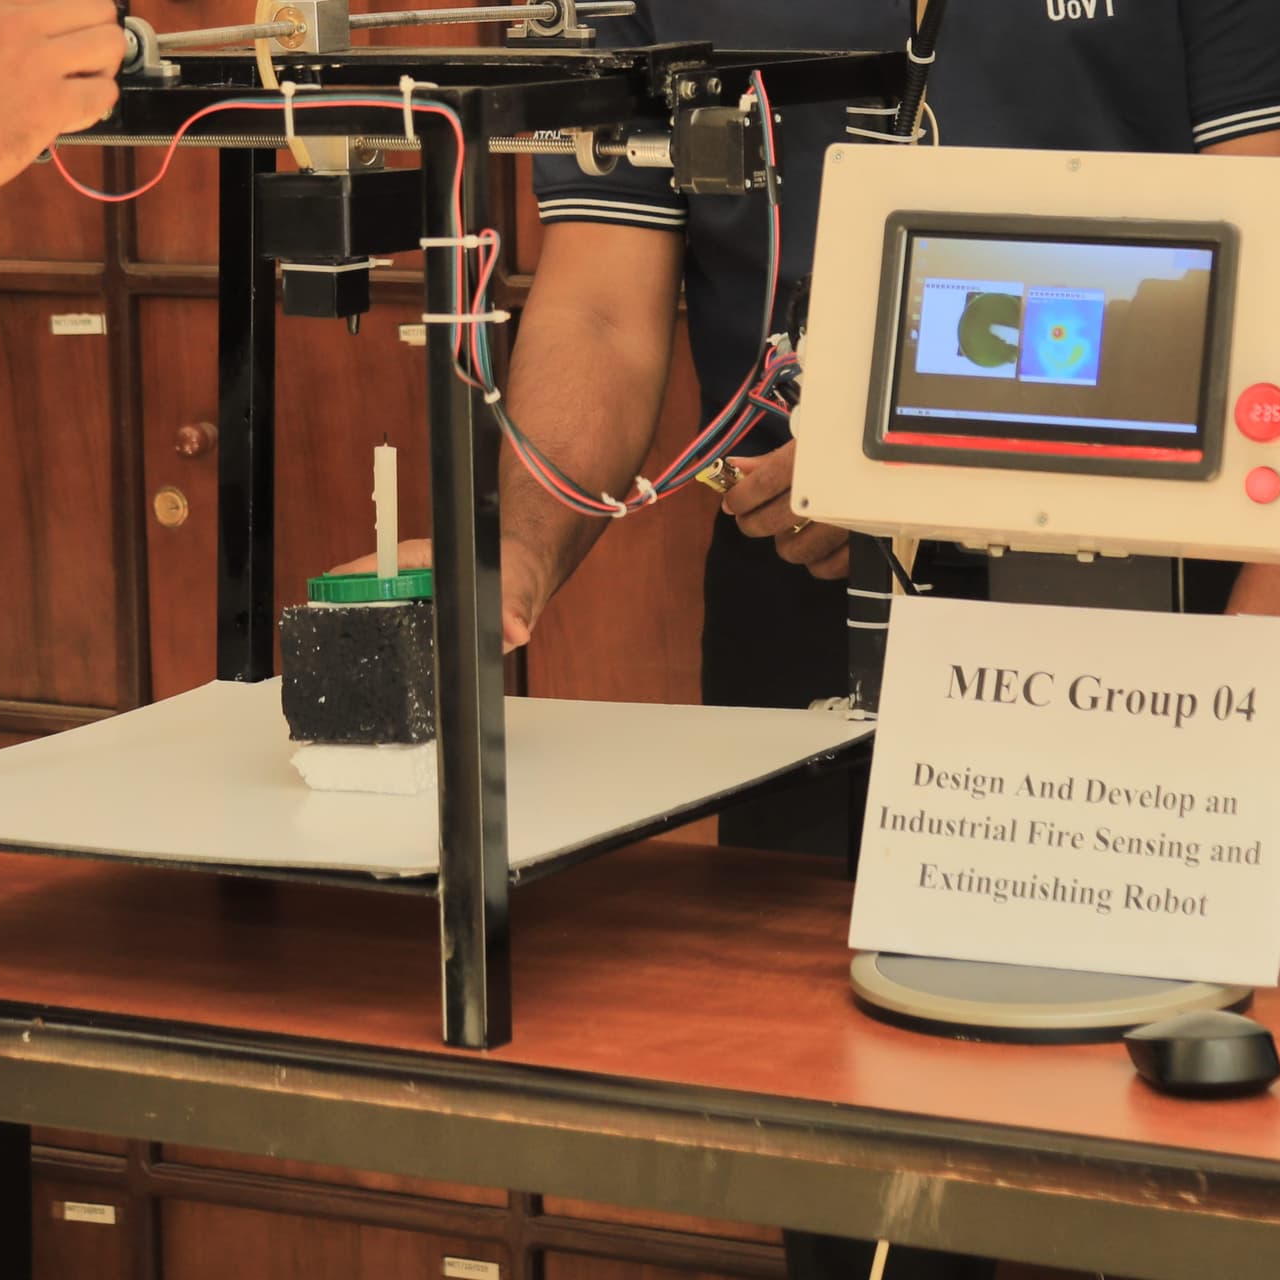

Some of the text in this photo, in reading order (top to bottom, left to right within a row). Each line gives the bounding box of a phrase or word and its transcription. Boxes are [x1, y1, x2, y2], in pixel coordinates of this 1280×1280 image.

[947, 664, 1256, 728] MEC Group 04
[914, 763, 1237, 818] Design And Develop an
[880, 806, 1261, 867] Industrial Fire Sensing and
[920, 863, 1206, 916] Extinguishing Robot
